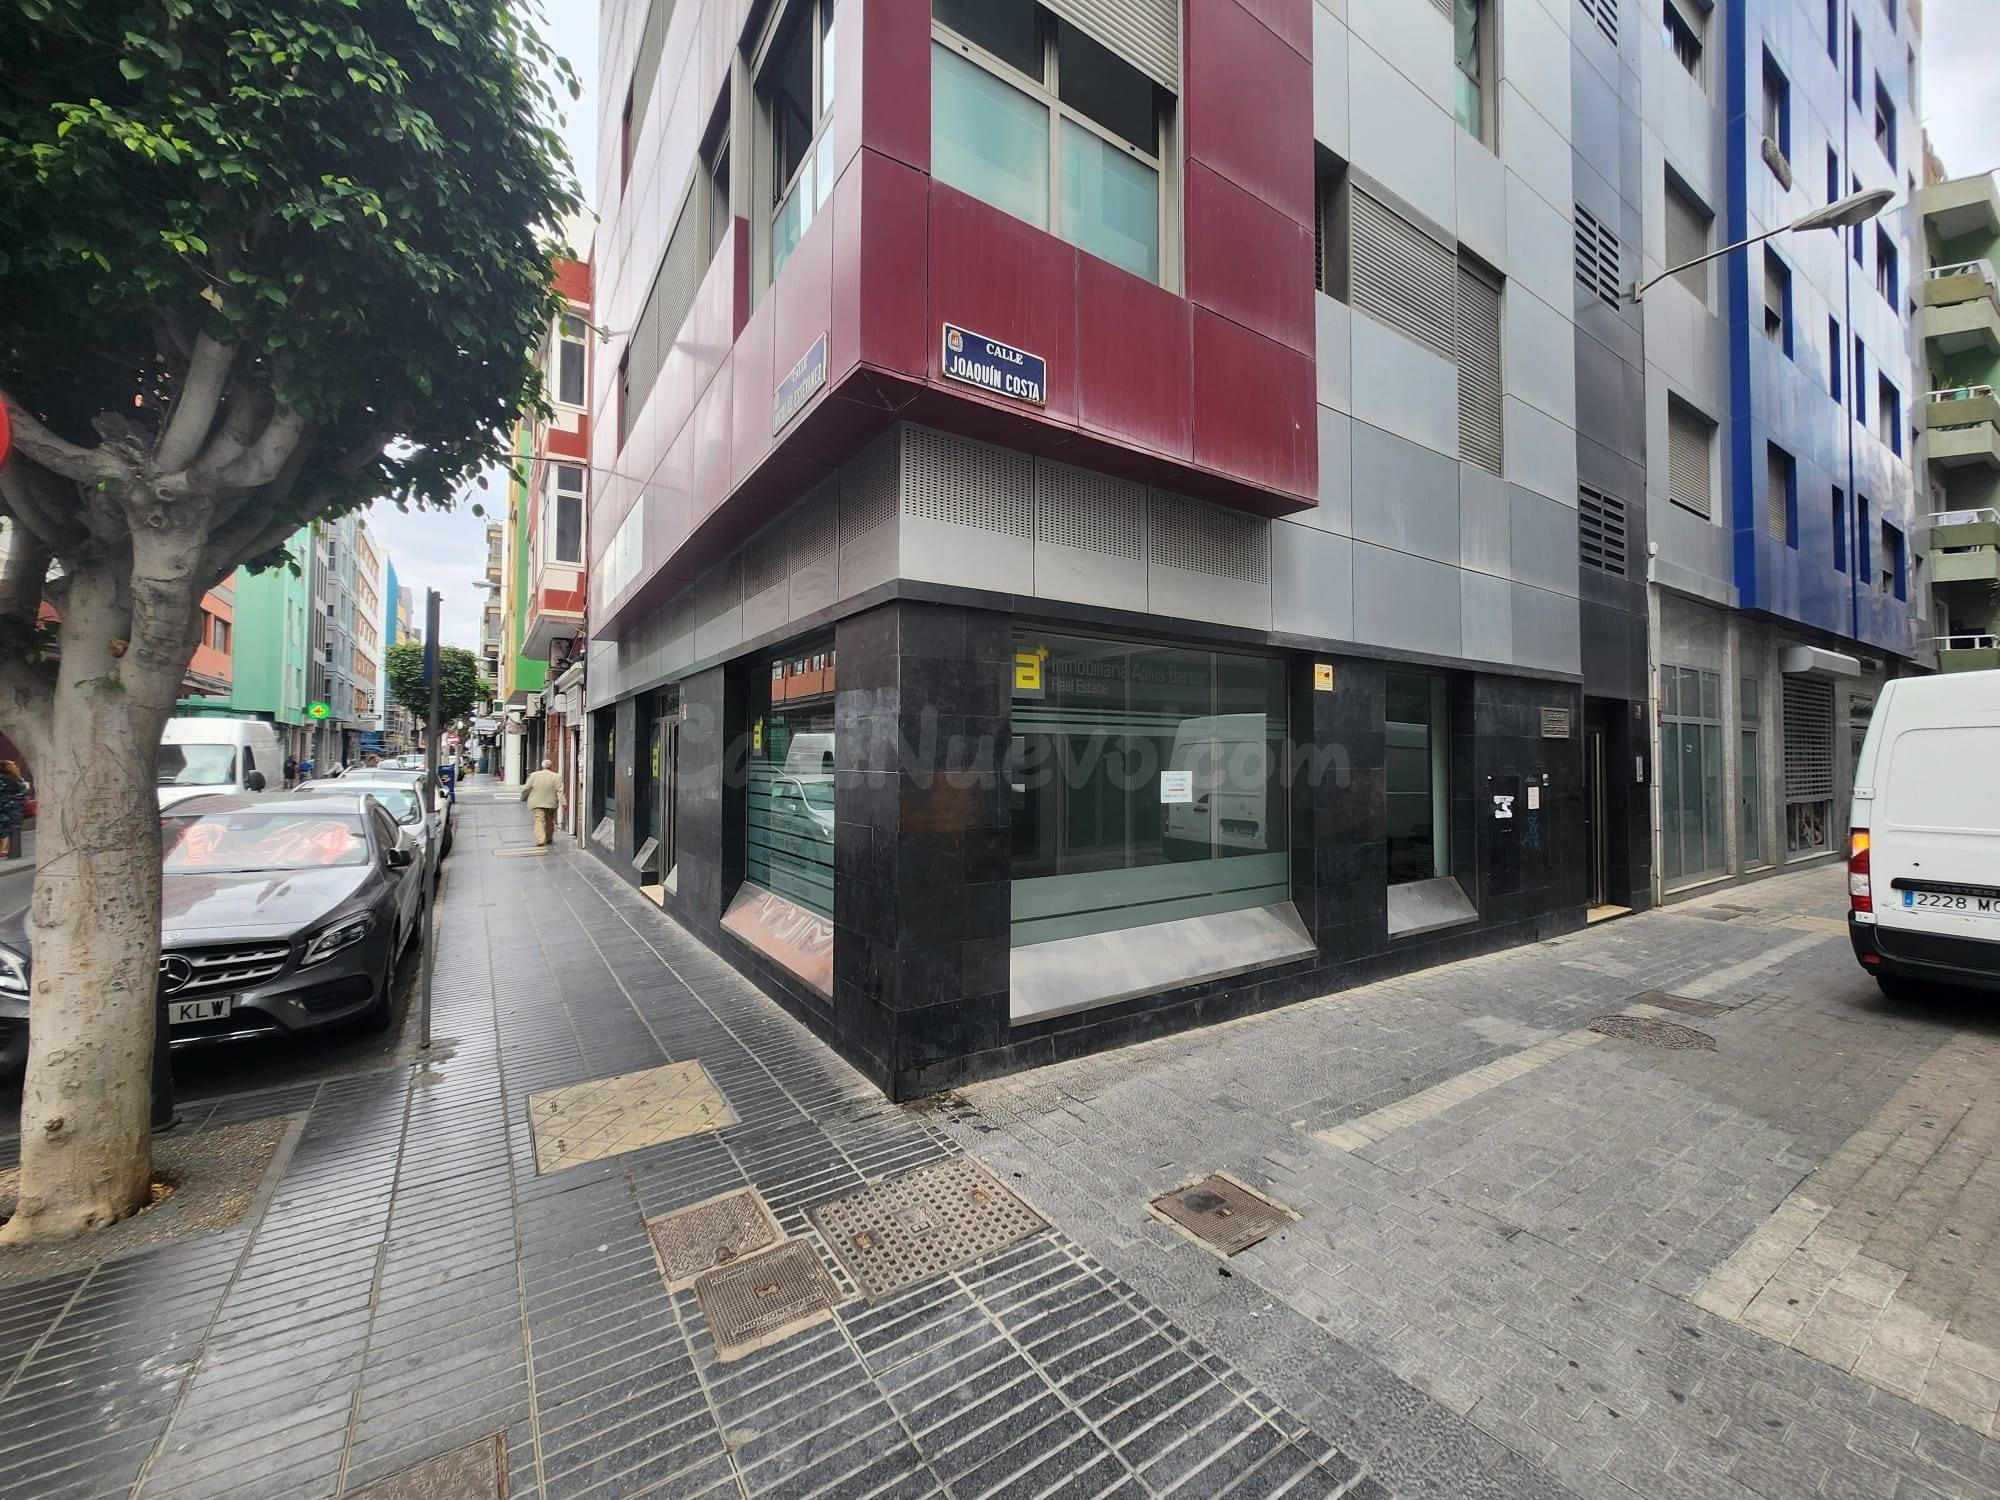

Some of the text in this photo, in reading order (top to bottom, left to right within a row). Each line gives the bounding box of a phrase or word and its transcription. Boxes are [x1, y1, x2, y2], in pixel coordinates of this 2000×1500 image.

[986, 343, 1024, 365] CALLE
[950, 355, 1040, 401] JOAQUÍN COSTA
[1052, 676, 1108, 696] Real Estate
[1917, 892, 1968, 910] 2228
[180, 1000, 224, 1021] KLW
